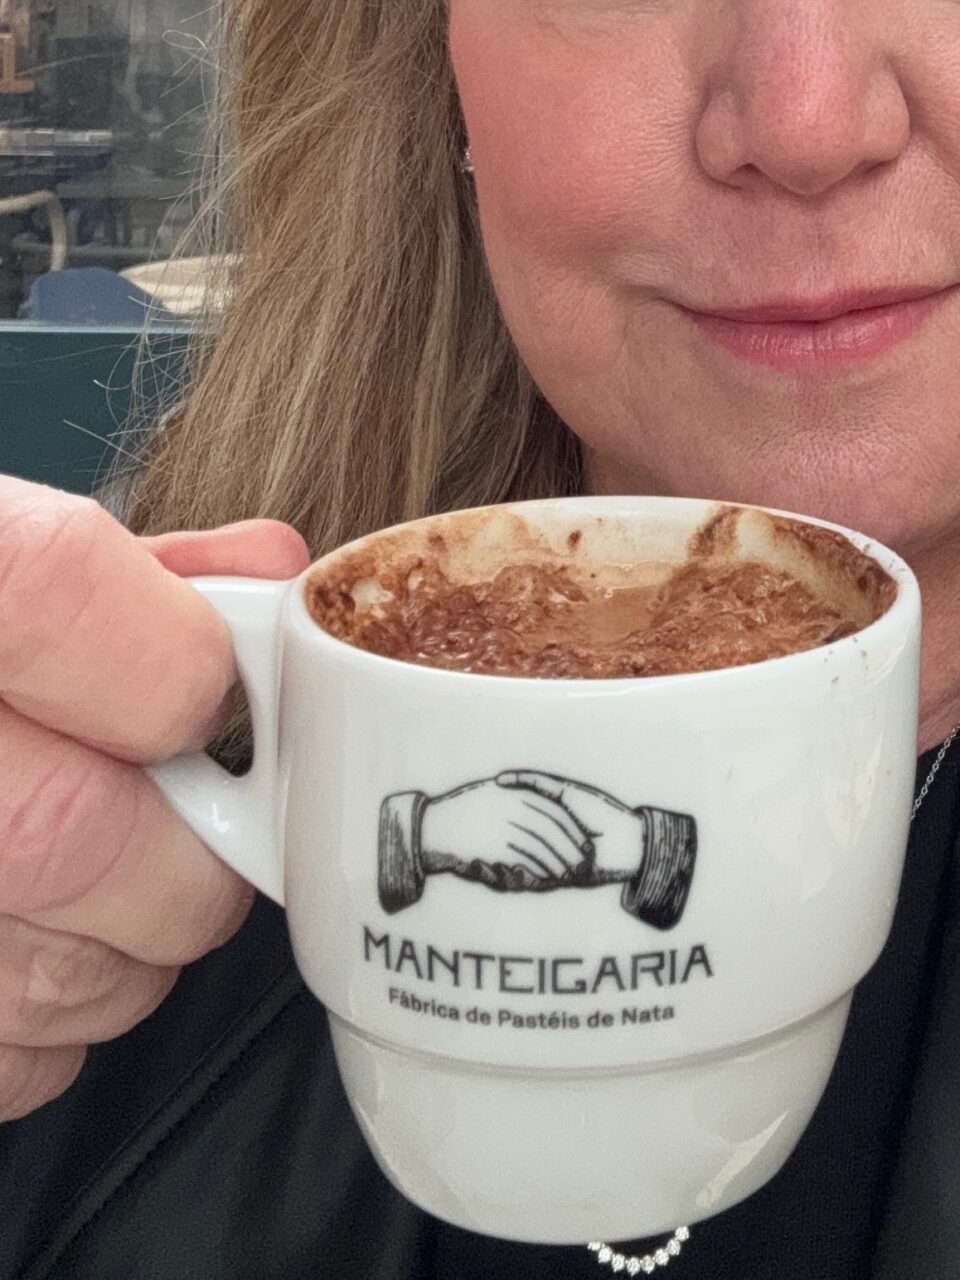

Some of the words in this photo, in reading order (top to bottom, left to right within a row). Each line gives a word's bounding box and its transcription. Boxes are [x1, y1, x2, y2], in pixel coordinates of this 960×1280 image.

[363, 925, 714, 996] MANTEIGARIA
[388, 987, 460, 1021] Fábrica
[466, 1006, 491, 1026] de
[498, 1008, 580, 1029] Pastéis
[587, 1011, 613, 1028] de
[622, 1005, 675, 1026] Nata
